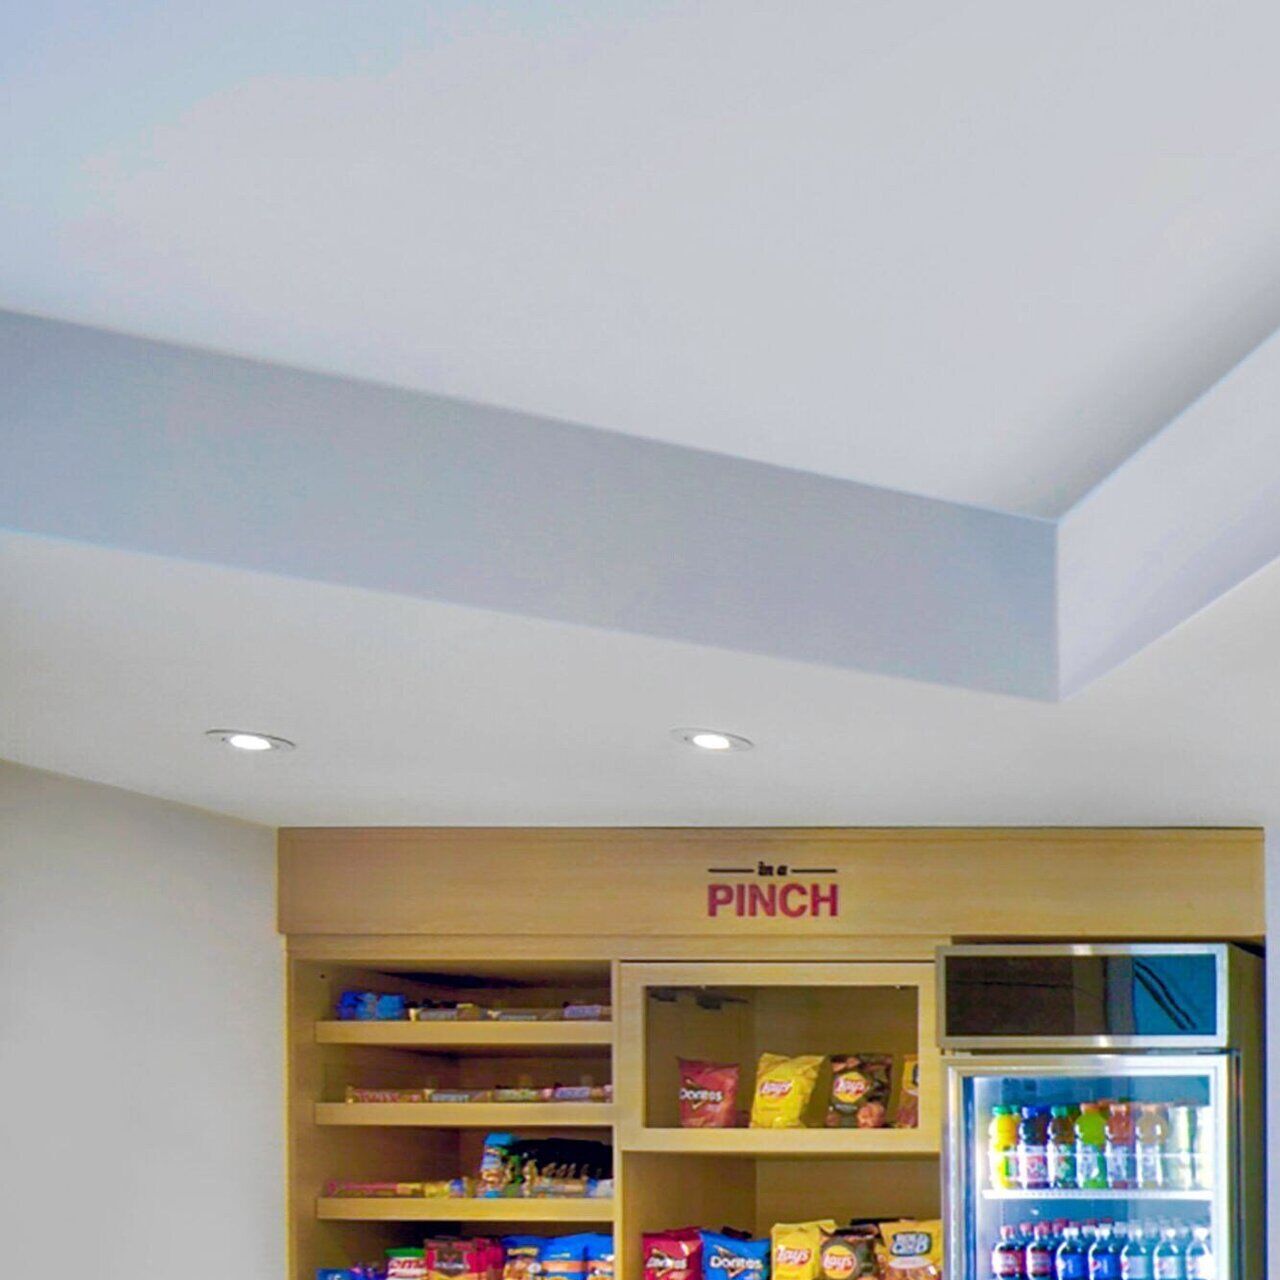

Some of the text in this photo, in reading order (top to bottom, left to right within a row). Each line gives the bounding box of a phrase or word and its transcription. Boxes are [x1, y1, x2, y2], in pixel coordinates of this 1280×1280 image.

[757, 861, 788, 877] in a
[707, 883, 839, 918] PINCH
[679, 1087, 724, 1101] Doritos
[709, 1254, 763, 1271] Doritos
